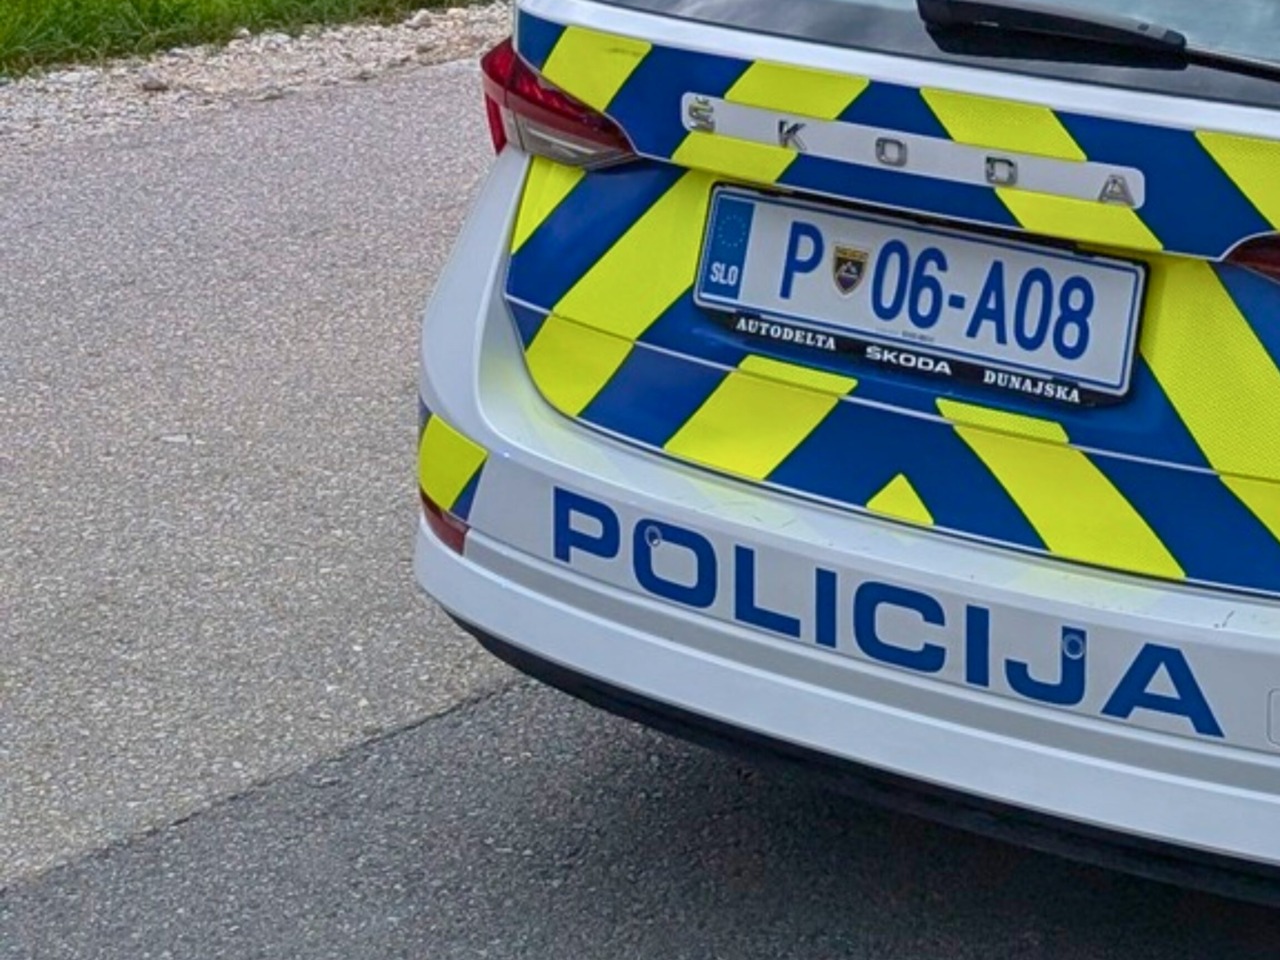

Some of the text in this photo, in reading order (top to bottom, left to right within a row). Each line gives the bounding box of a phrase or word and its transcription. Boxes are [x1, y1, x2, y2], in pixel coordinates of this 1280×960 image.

[688, 96, 1136, 207] ŠKODA
[709, 261, 738, 287] SLO
[779, 220, 1095, 360] P 06-A08
[735, 316, 836, 351] AUTODELTA
[865, 344, 952, 376] ŠKODA
[983, 369, 1081, 404] DUNAJSKA
[552, 485, 1225, 739] POLICIJA
